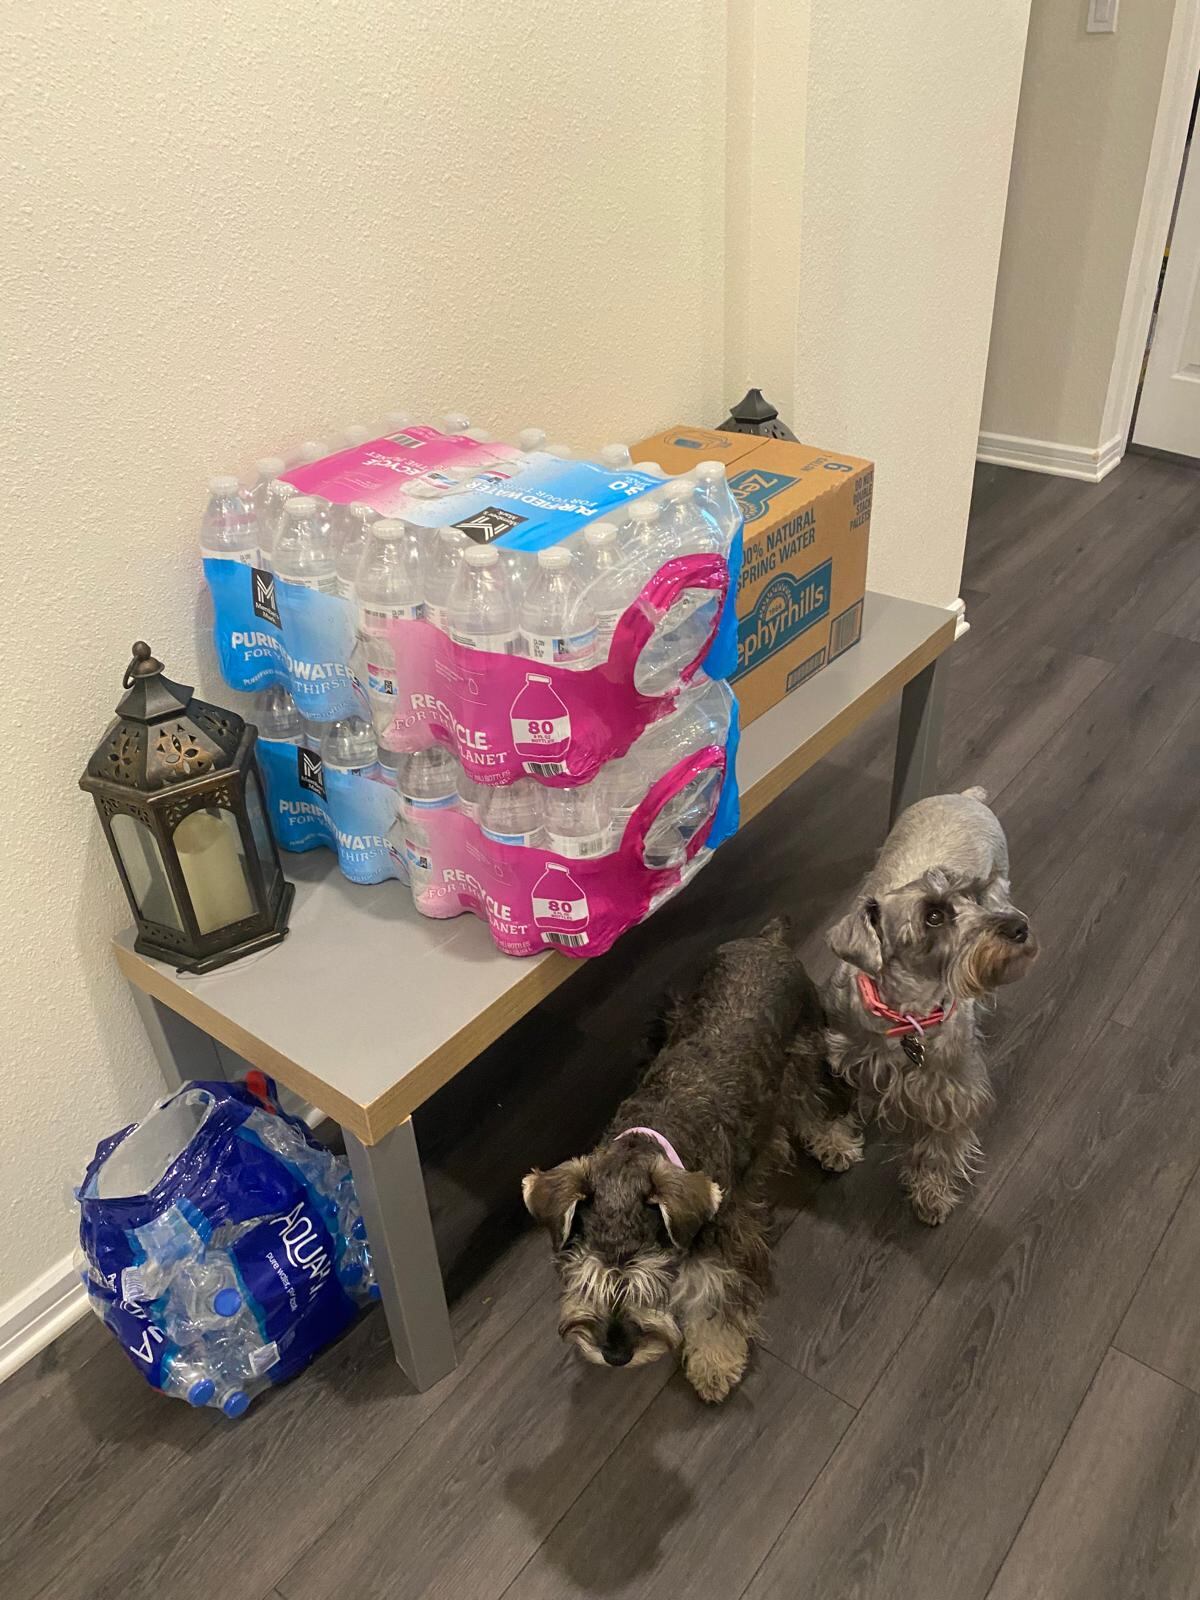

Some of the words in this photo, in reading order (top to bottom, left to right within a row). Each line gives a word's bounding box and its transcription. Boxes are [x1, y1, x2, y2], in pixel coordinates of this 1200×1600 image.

[466, 481, 523, 500] WATER
[742, 543, 764, 568] 00%
[766, 507, 816, 552] NATURAL
[737, 553, 776, 592] SPRING
[779, 527, 815, 563] WATER
[737, 582, 824, 666] ephyrhills
[231, 632, 293, 673] PURIFD
[293, 661, 356, 683] WATER
[244, 648, 273, 662] FOR
[295, 678, 346, 695] THIRST
[395, 711, 427, 731] FOR
[528, 721, 554, 735] 80
[280, 799, 339, 839] PURIF
[339, 831, 394, 851] WATER
[428, 884, 457, 899] FOR
[549, 901, 572, 913] 80
[265, 1252, 280, 1270] pure
[270, 1201, 331, 1303] AQUAF
